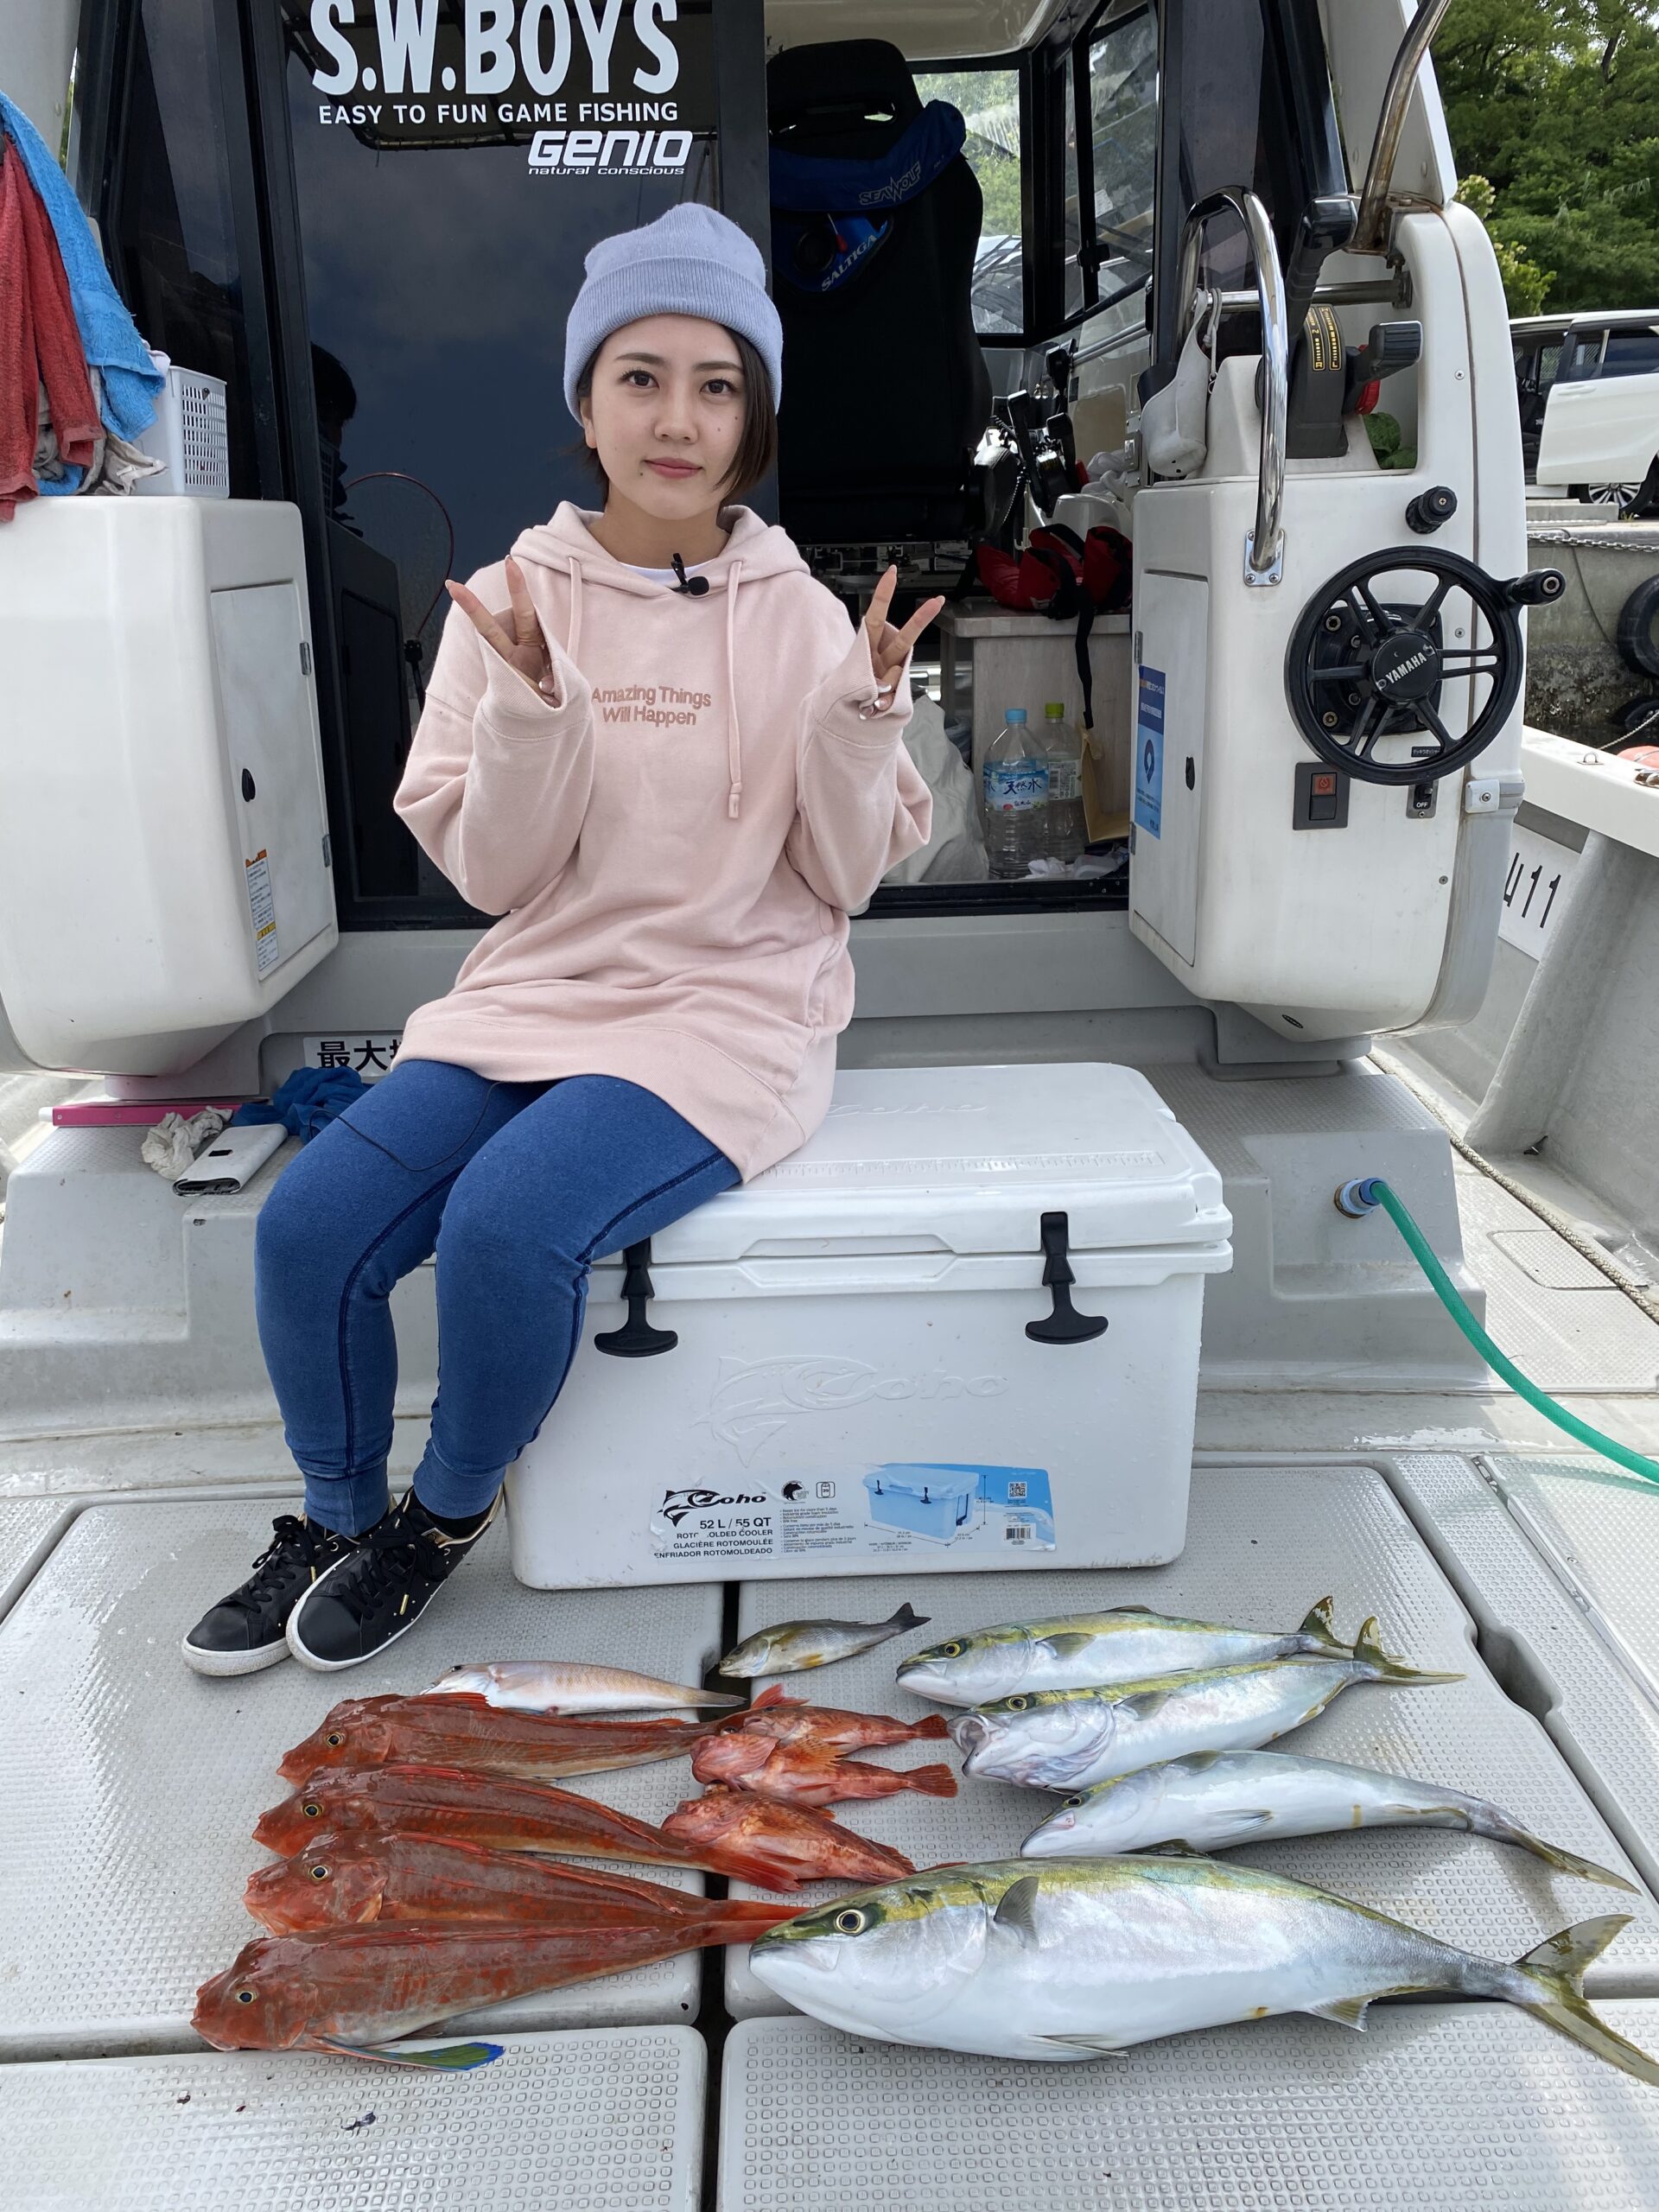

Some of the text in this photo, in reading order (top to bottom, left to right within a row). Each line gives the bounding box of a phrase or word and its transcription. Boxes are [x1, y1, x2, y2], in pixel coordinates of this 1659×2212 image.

[311, 0, 679, 96] S.W.BOYS
[319, 102, 677, 124] EASY TO FUN GAME FISHING
[529, 167, 684, 175] natural conscious
[859, 161, 921, 206] SEAWOLF
[822, 233, 878, 291] SALTIGA
[1385, 652, 1427, 685] YAMAHA
[591, 685, 712, 709] Amazing Things
[602, 706, 696, 728] Will Happen
[1002, 778, 1042, 795] 天然水
[317, 1039, 402, 1071] 最大
[700, 1520, 715, 1529] 52
[718, 1519, 726, 1529] L
[735, 1518, 750, 1528] 55
[753, 1516, 772, 1527] QT
[673, 1540, 715, 1549] GLACIÈRE
[716, 1538, 773, 1548] ROTOMOULÉE
[703, 1548, 772, 1556] ROTOMOLDEADO
